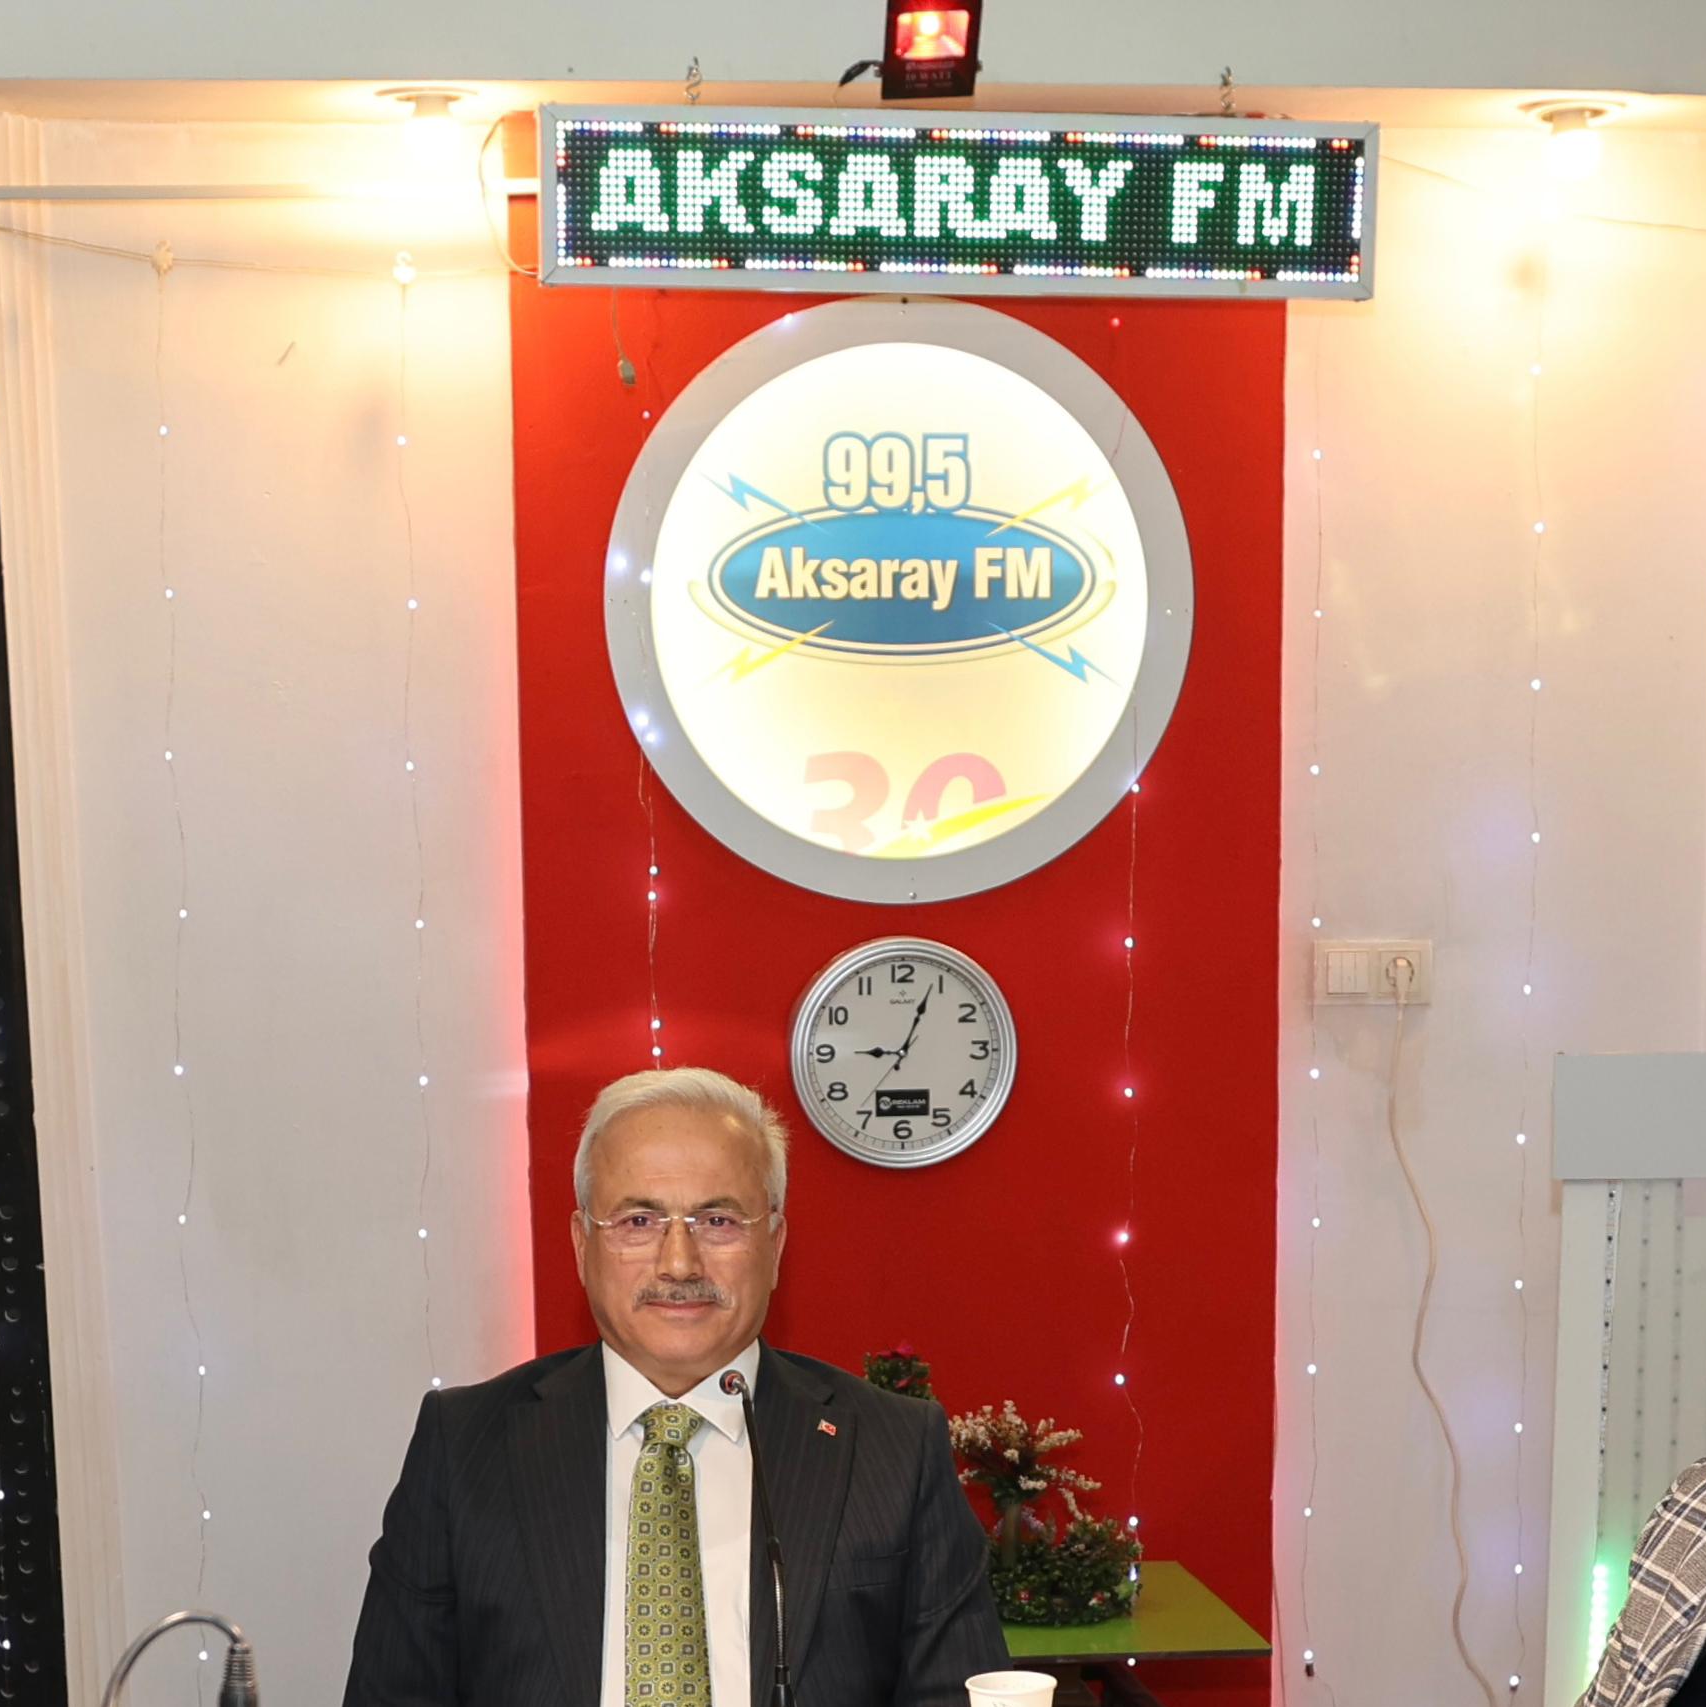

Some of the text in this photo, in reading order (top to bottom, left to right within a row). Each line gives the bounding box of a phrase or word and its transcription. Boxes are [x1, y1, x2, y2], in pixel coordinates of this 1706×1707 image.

[590, 148, 1316, 247] AKSARAY FM
[823, 431, 972, 514] 99,5
[754, 546, 1053, 611] Aksaray FM
[891, 964, 915, 983] 12
[858, 976, 872, 995] 11
[828, 1006, 848, 1025] 10
[958, 1003, 977, 1023] 2
[816, 1044, 835, 1063] 9
[970, 1040, 989, 1060] 3
[827, 1082, 848, 1101] 8
[959, 1079, 977, 1098] 4
[856, 1111, 872, 1130] 7
[931, 1108, 951, 1127] 5
[893, 1120, 913, 1139] 6
